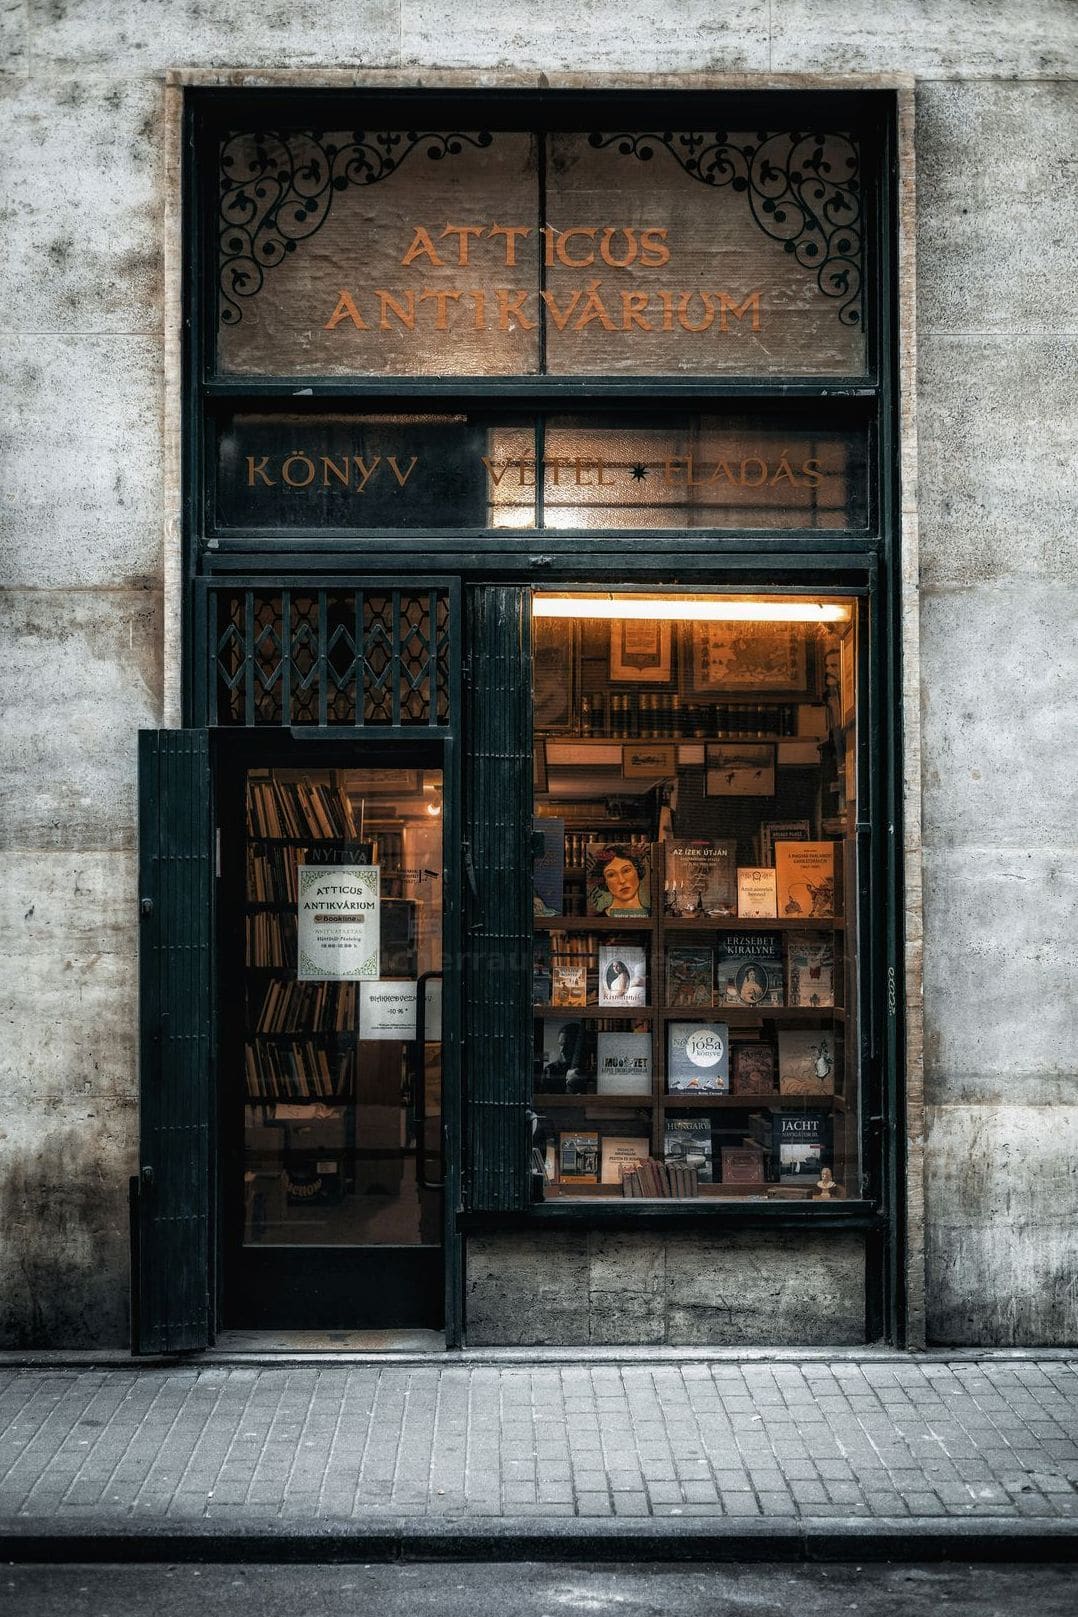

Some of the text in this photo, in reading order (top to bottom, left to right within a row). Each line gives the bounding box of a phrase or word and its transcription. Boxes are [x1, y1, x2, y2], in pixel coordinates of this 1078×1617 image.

[401, 221, 671, 268] ATTICUS
[324, 279, 764, 333] ANTIKVÁRIUM
[245, 447, 826, 493] KÖNYV VÉTEL ELADÁS
[312, 849, 367, 865] NYITVA
[316, 885, 363, 896] ATTICUS
[303, 900, 375, 910] ANTIKVÁRIUM
[692, 1036, 721, 1054] jóga
[781, 1120, 820, 1132] JACHT
